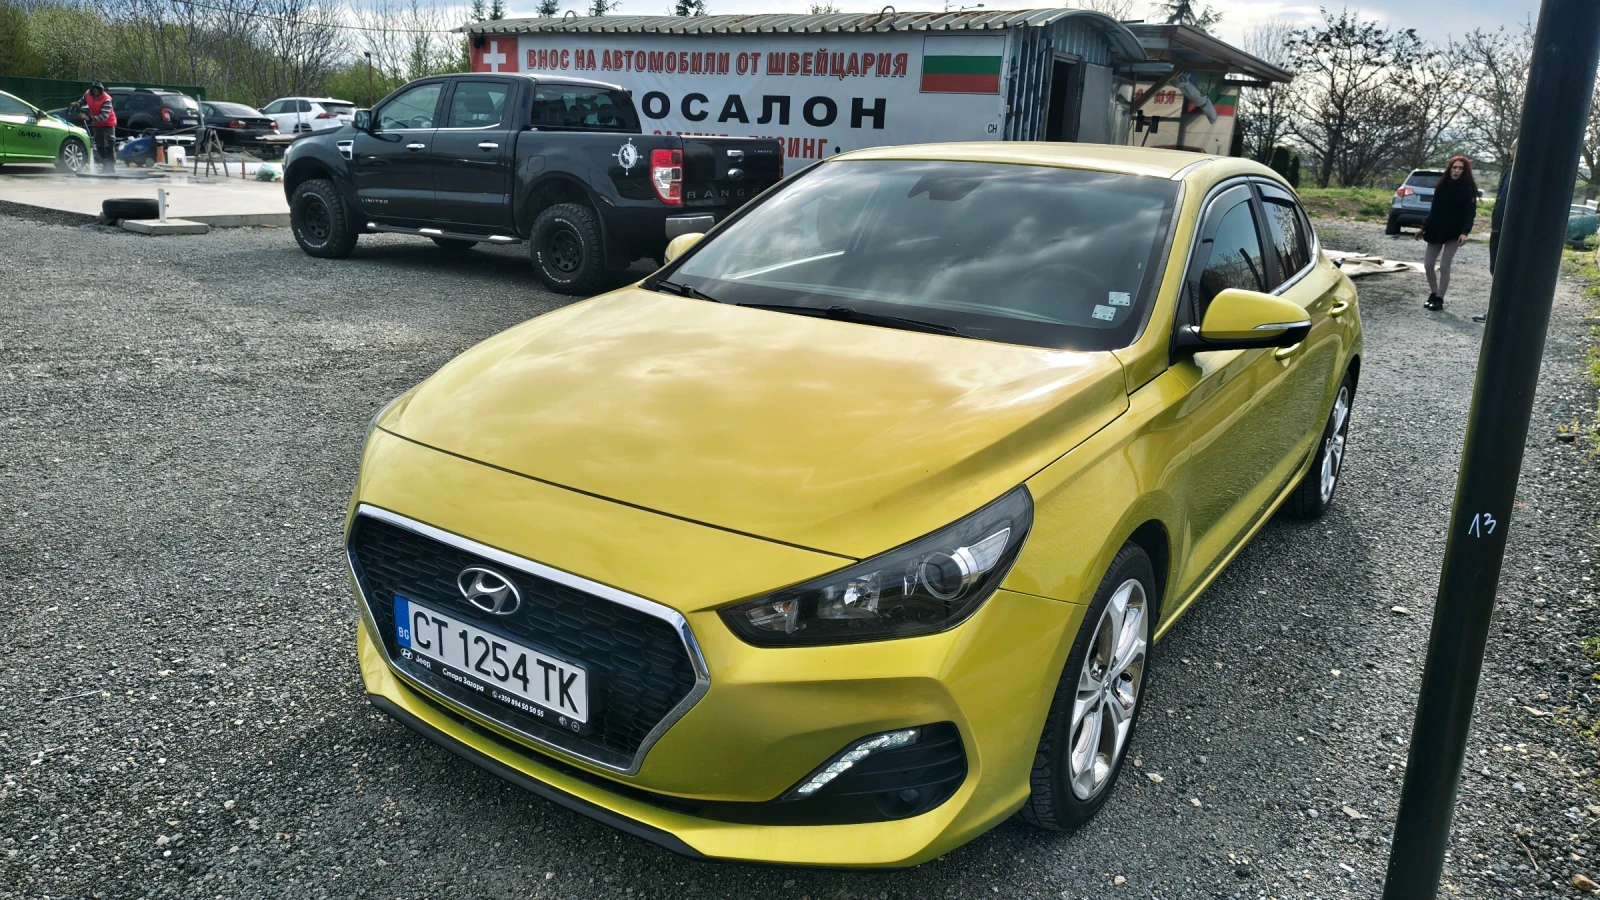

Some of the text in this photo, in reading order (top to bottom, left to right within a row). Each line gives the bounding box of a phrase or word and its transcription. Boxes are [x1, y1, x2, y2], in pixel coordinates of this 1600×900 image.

[527, 48, 909, 80] ВНОС НА АВТОМОБИЛИ ОТ ШВЕЙЦАРИЯ
[628, 90, 887, 130] ОСАЛОН
[987, 123, 998, 134] CH
[1468, 513, 1497, 538] 13
[398, 626, 410, 641] BG
[415, 655, 431, 669] Jeep
[458, 629, 530, 693] 1254
[498, 694, 511, 703] +359
[511, 699, 521, 708] 894
